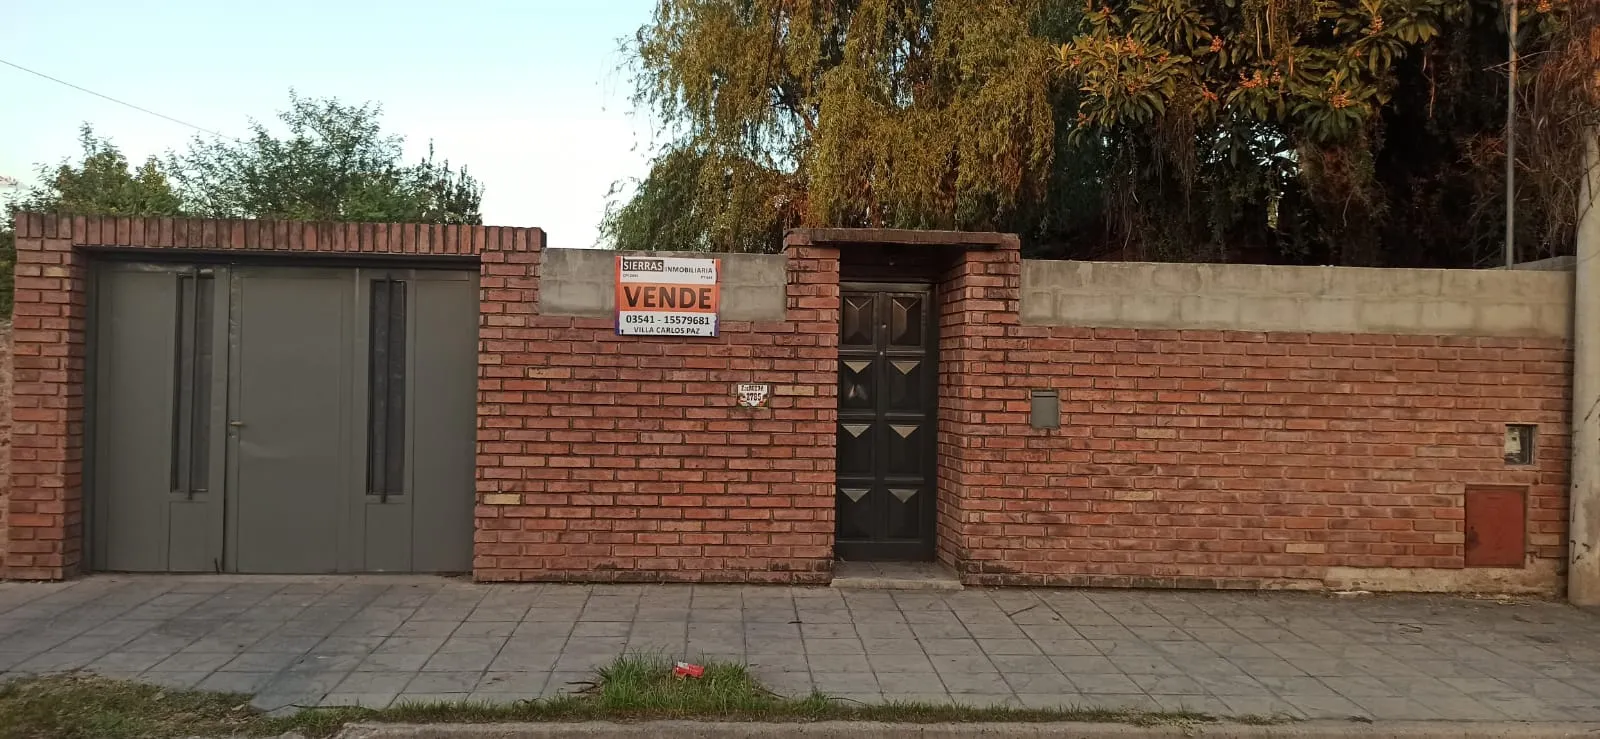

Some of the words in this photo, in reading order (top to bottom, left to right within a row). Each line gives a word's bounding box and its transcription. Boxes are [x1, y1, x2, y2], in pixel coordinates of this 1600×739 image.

[623, 260, 664, 271] SIERRAS
[665, 266, 713, 274] INMOBILIARIA
[623, 286, 712, 309] VENDE
[626, 315, 654, 324] 03541
[664, 315, 710, 325] 15579681
[656, 326, 685, 334] CARLOS
